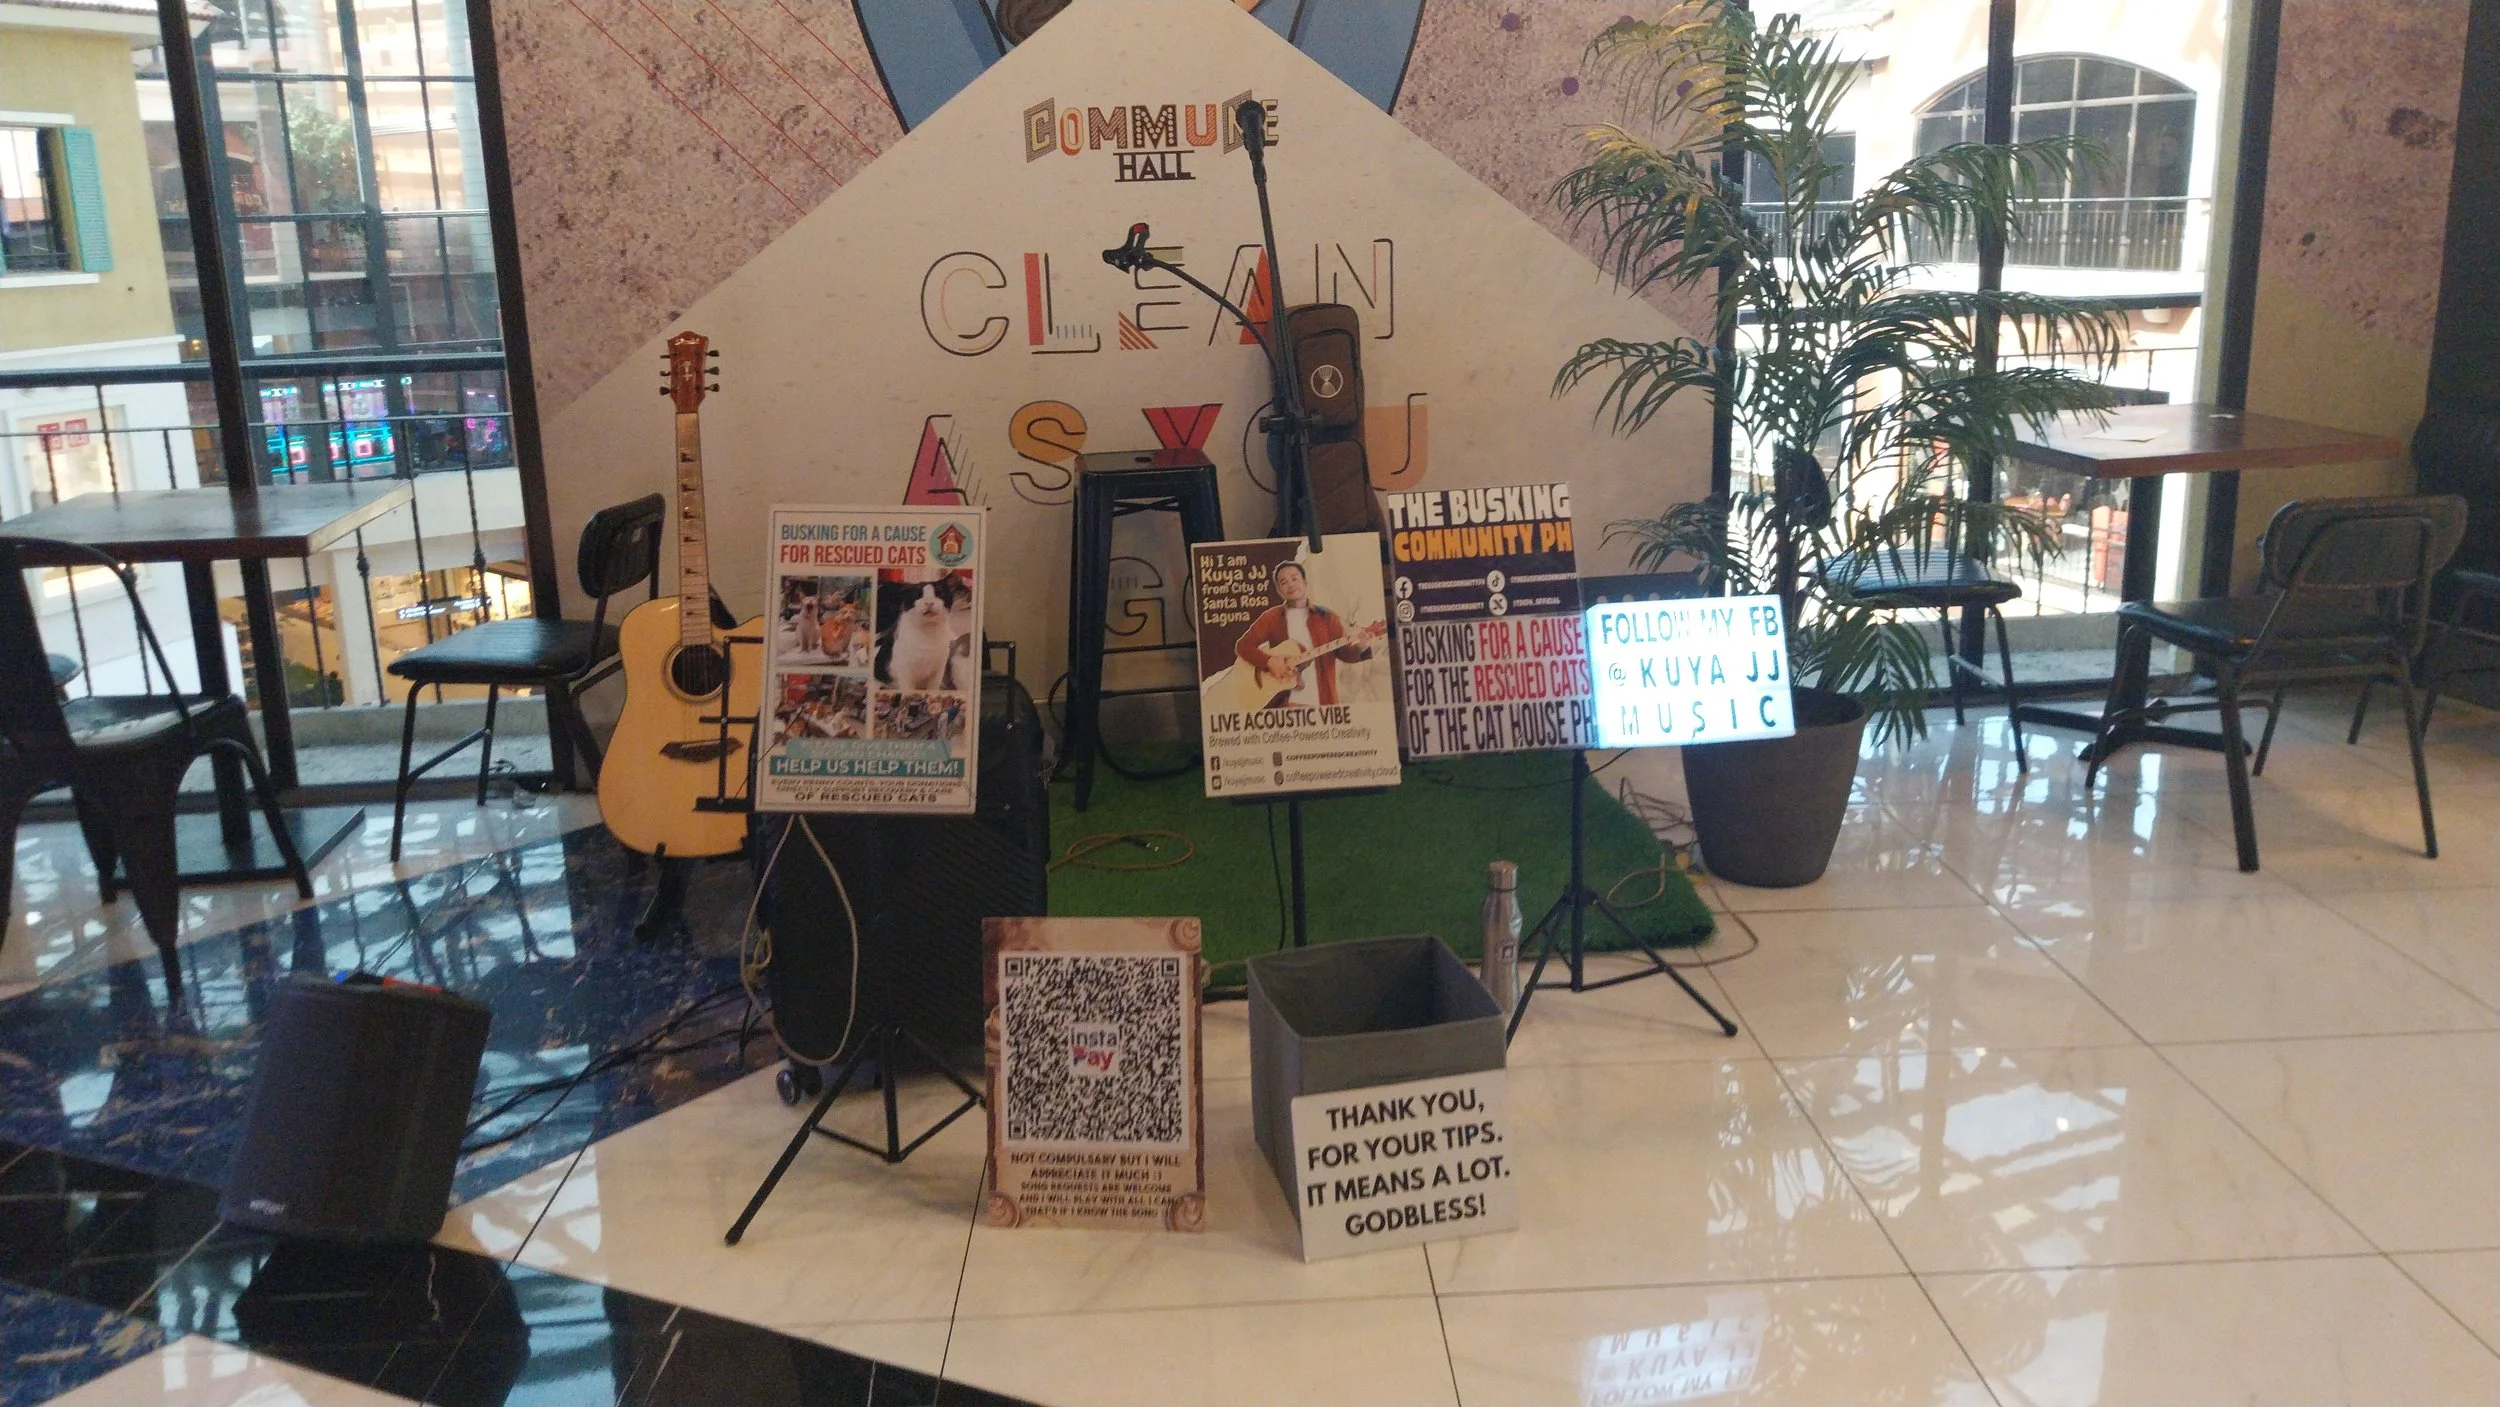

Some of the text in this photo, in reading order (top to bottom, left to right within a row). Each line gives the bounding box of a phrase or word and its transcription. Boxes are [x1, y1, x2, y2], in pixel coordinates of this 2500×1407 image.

[1115, 151, 1195, 182] HALL
[921, 238, 1394, 356] CLEAN
[903, 400, 1087, 506] AS
[1388, 483, 1572, 529] THE BUSKING
[782, 524, 926, 542] BUSKING FOR A CAUSE
[1394, 521, 1573, 562] COMMUNITY PH
[780, 545, 810, 563] FOR
[814, 545, 882, 564] RESCUED
[888, 546, 925, 564] CATS
[1200, 554, 1247, 568] Hi I am
[1201, 564, 1267, 586] Kuya JJ
[1202, 579, 1270, 595] from City of
[1203, 595, 1269, 610] Santa Rosa
[1204, 611, 1250, 627] Laguna
[1601, 605, 1779, 644] FOLLOW MY FB
[1402, 617, 1584, 665] BUSKING FOR A CAUSE
[1405, 658, 1590, 706] FOR THE RESCUED CATS
[1608, 650, 1780, 688] @ KUYA JJ
[1210, 706, 1351, 733] LIVE ACOUSTIC VIBE
[1408, 698, 1594, 754] OF THE CAT HOUSE PH
[1621, 695, 1776, 738] MUSIC
[1209, 734, 1241, 748] Brewed
[1243, 733, 1261, 745] with
[1331, 726, 1371, 741] Creativity
[776, 758, 958, 775] HELP US HELP THEM!
[795, 792, 937, 803] OF RESCUED CATS
[1071, 1028, 1117, 1047] insta
[1073, 1045, 1114, 1072] Pay
[1326, 1088, 1485, 1131] THANK YOU,
[1308, 1121, 1503, 1170] FOR YOUR TIPS.
[1011, 1153, 1035, 1164] NOT
[1120, 1154, 1142, 1166] BUT
[1145, 1155, 1149, 1166] I
[1153, 1155, 1181, 1167] WILL
[1021, 1181, 1048, 1191] SONG
[1102, 1183, 1119, 1192] ARE
[1123, 1183, 1172, 1194] WELCOME
[1031, 1168, 1096, 1179] APPRECIATE
[1101, 1169, 1110, 1180] IT
[1115, 1169, 1150, 1180] MUCH
[1307, 1155, 1511, 1208] IT MEANS A LOT.
[1019, 1193, 1039, 1203] AND
[1047, 1194, 1069, 1203] WILL
[1073, 1195, 1098, 1204] PLAY
[1128, 1195, 1145, 1205] ALL
[1112, 1207, 1128, 1217] THE
[1345, 1192, 1486, 1236] GODBLESS!
